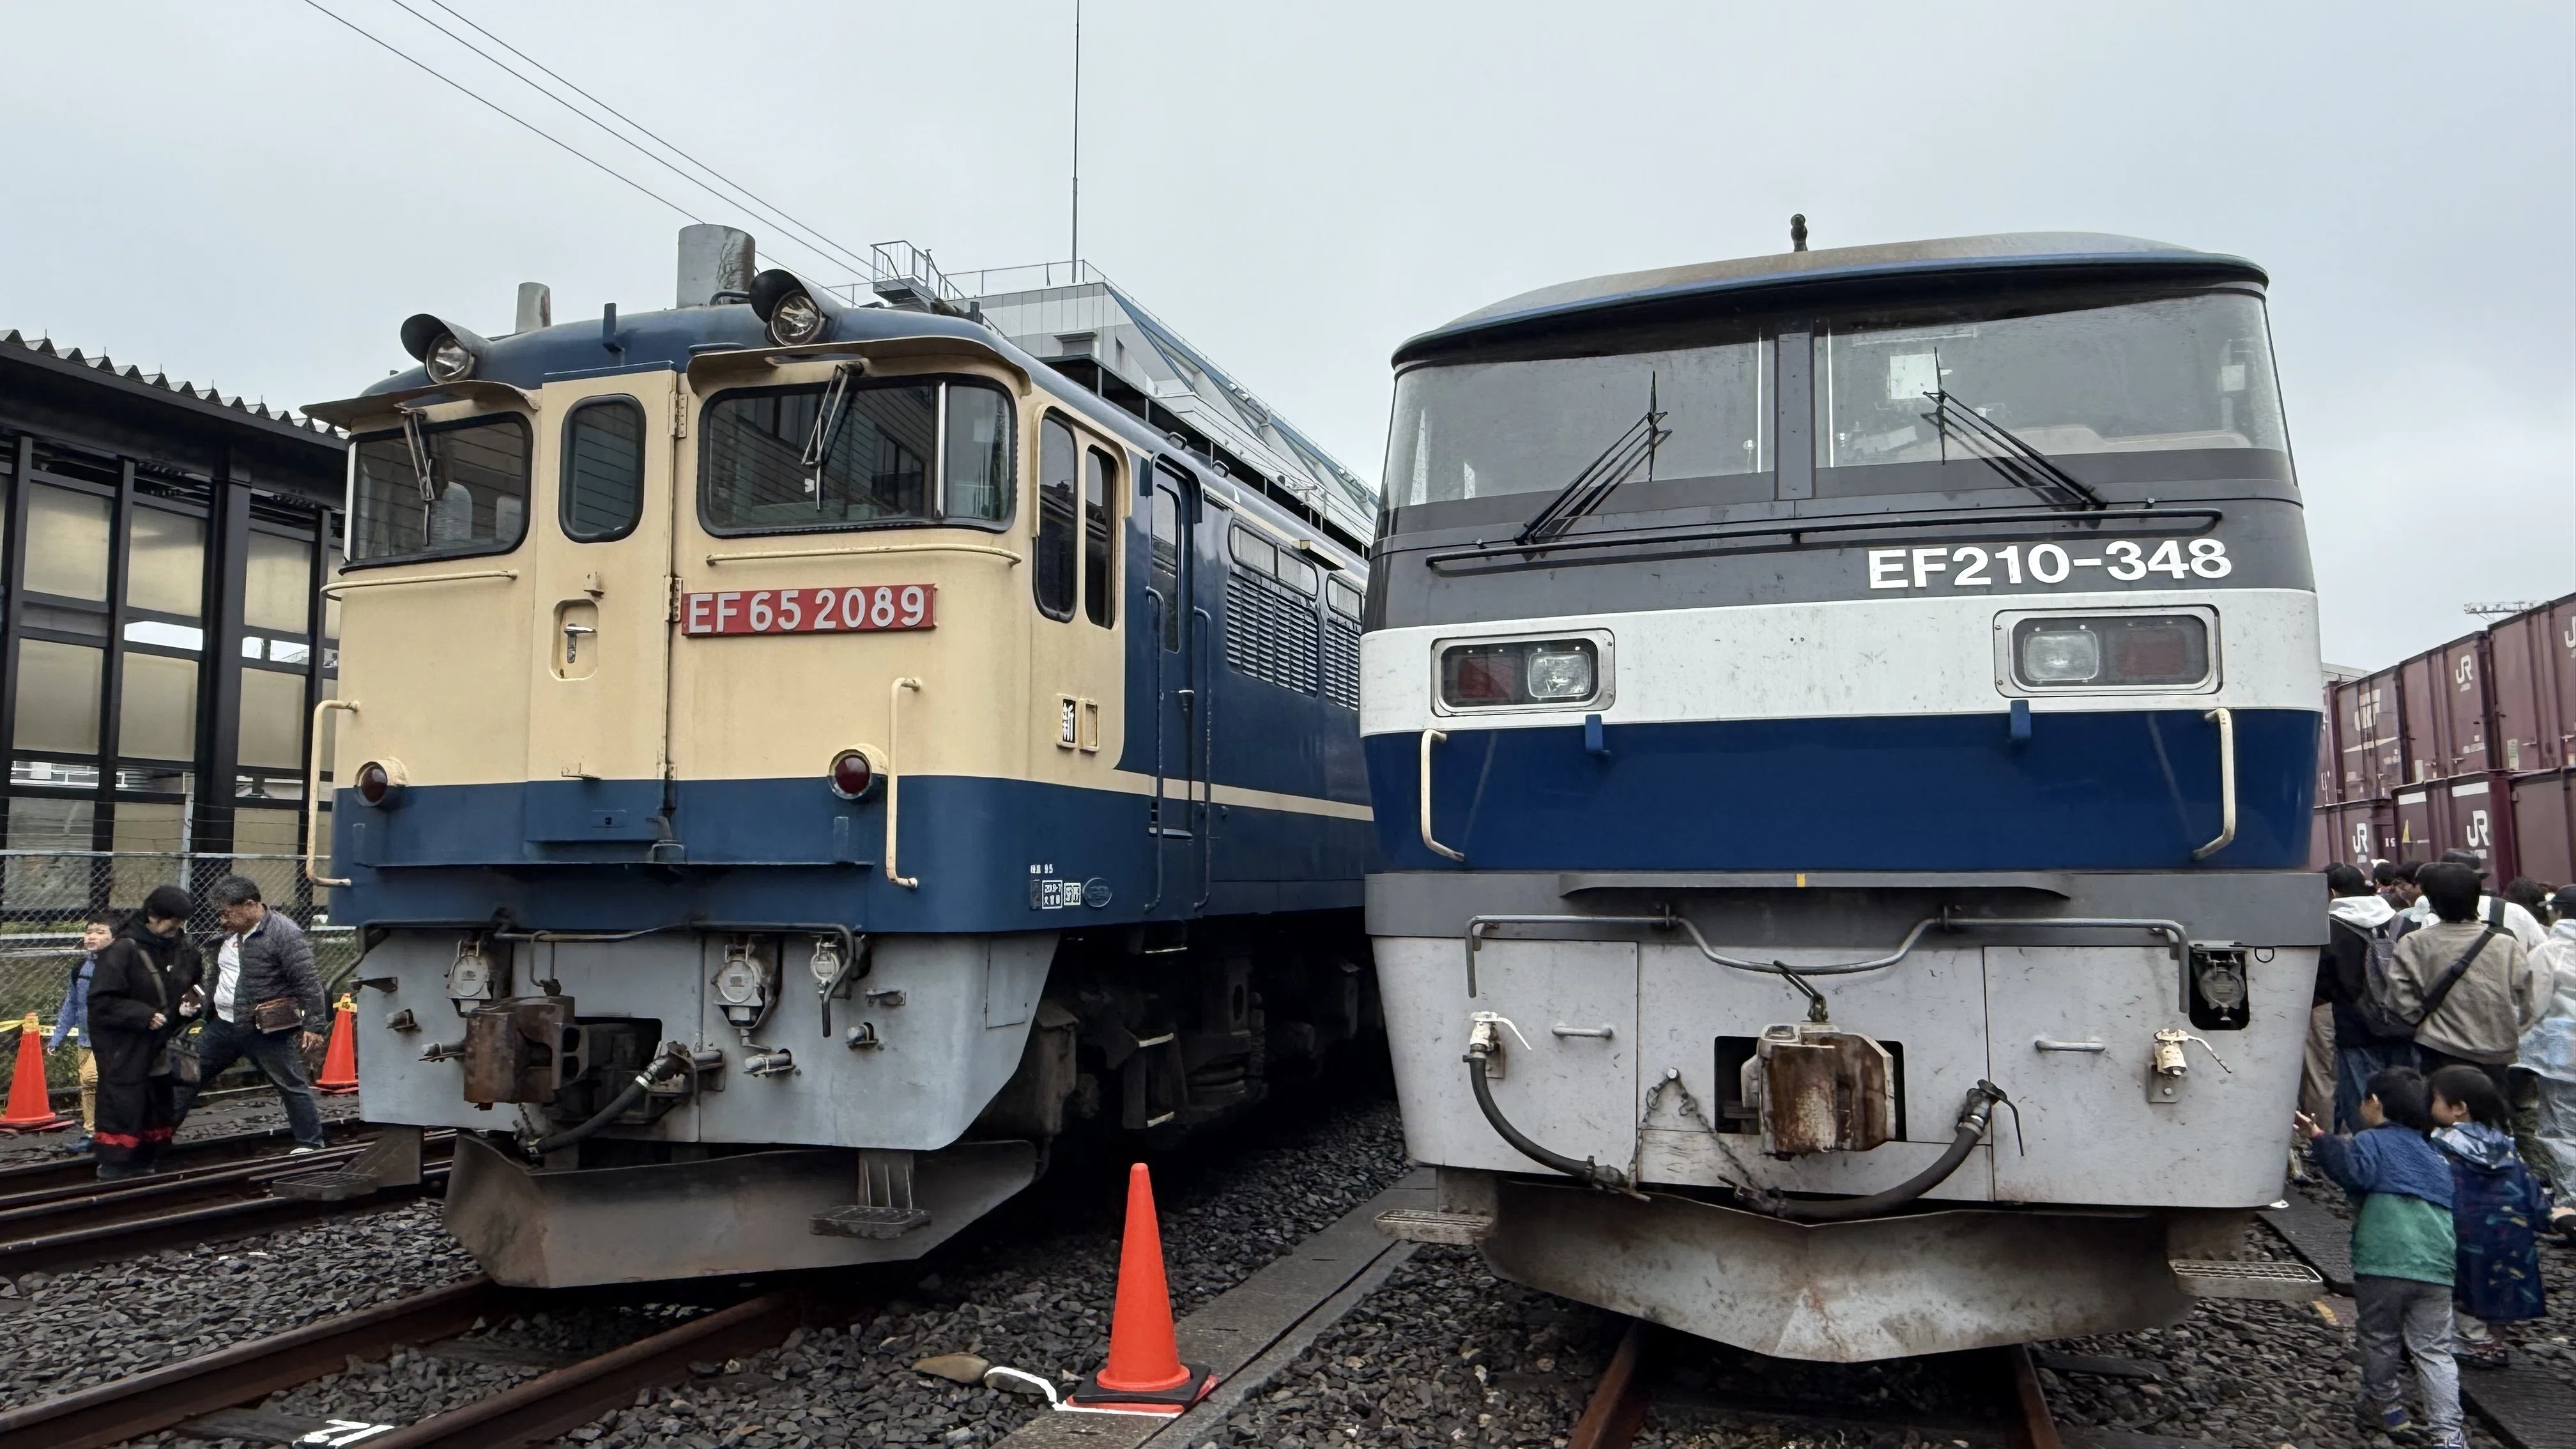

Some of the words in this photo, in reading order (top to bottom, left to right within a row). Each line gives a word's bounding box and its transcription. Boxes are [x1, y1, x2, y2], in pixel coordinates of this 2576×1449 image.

[1867, 538, 2232, 589] EF210-348
[689, 592, 741, 633] EF
[813, 585, 924, 630] 2089
[2455, 655, 2473, 684] JR
[2352, 823, 2368, 853] JR
[2467, 810, 2490, 847] JR
